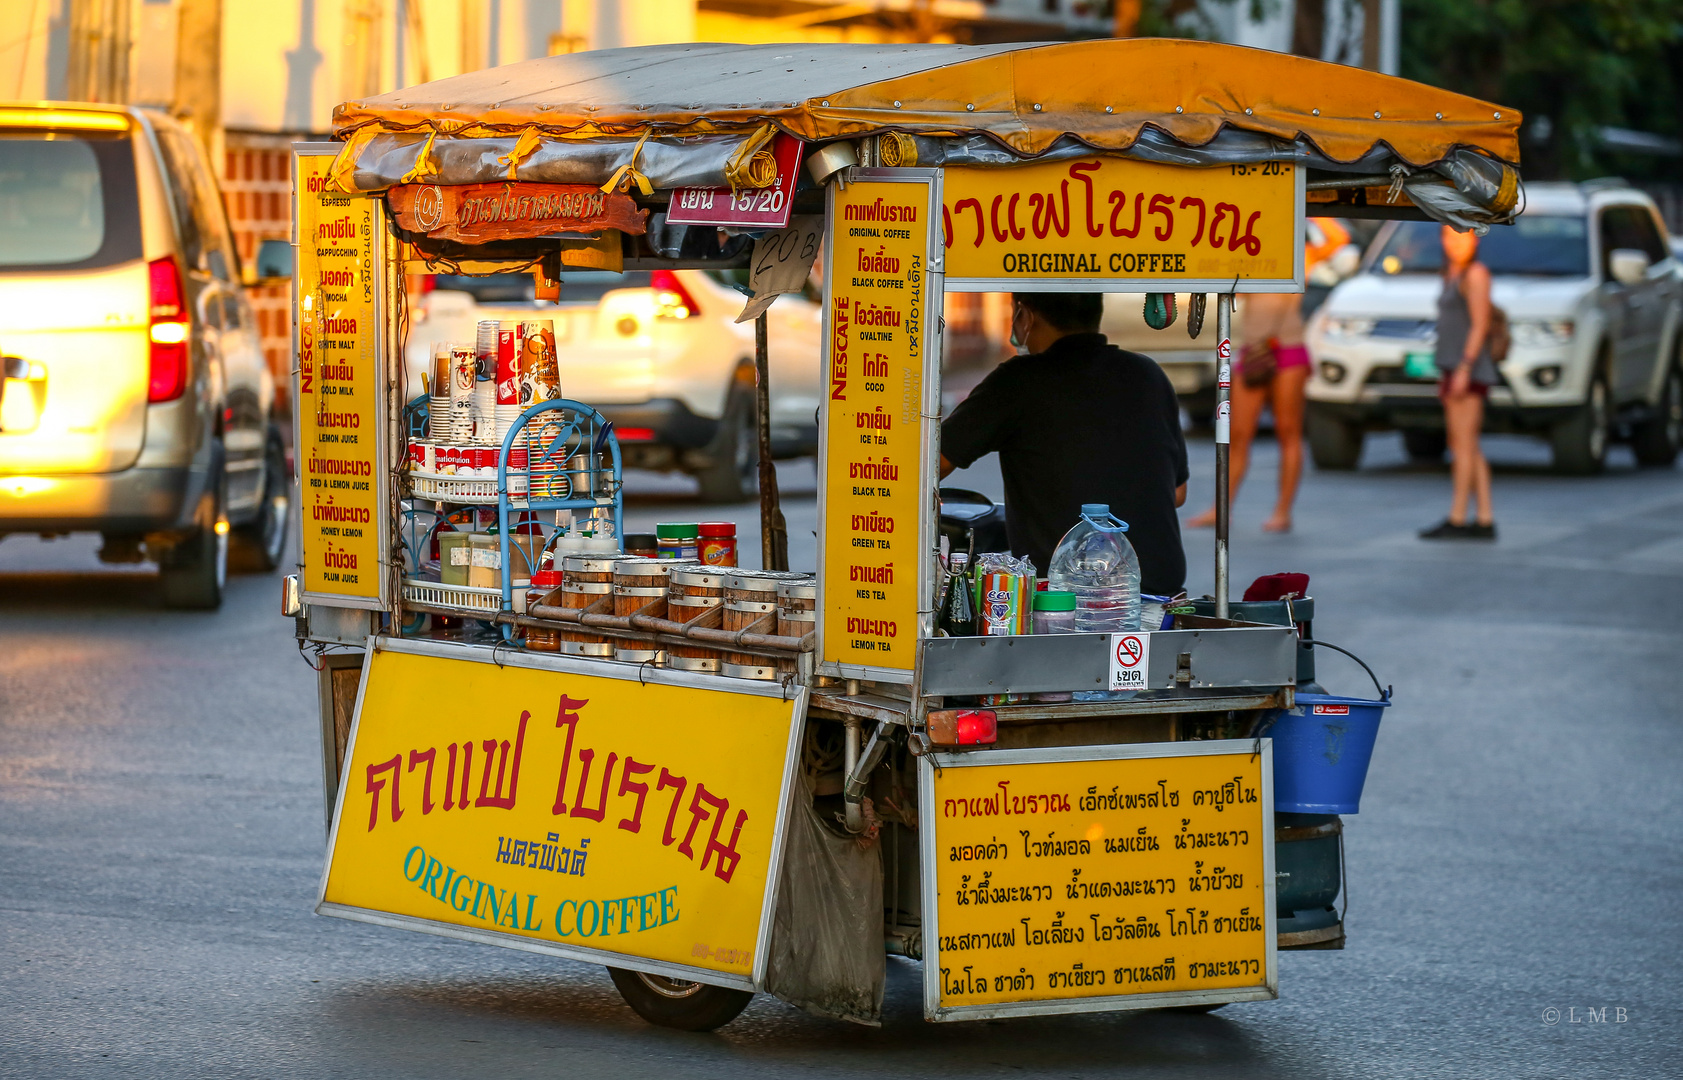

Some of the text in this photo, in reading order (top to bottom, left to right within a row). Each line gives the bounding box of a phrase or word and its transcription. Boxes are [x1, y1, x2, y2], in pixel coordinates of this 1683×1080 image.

[1262, 160, 1290, 176] 20.-
[322, 198, 351, 206] ESPRESSO
[730, 190, 784, 212] 15/20
[844, 198, 916, 222] กาแฟโบราณ
[320, 216, 356, 246] คาปูชิโน
[849, 228, 910, 239] ORIGINAL COFFEE
[755, 230, 798, 276] 20
[858, 245, 900, 274] โอเลี้ยง
[1002, 253, 1186, 272] ORIGINAL COFFEE
[852, 278, 904, 288] BLACK COFFEE
[326, 294, 348, 302] MOCHA
[905, 254, 920, 357] เหมือนเดิม
[854, 300, 900, 327] โอวัลติน
[302, 294, 312, 394] NESCAF
[338, 340, 354, 350] MALT
[860, 332, 892, 342] OVALTINE
[320, 358, 354, 381] นมเย็น
[863, 352, 888, 378] โกโก้
[338, 386, 354, 396] MILK
[865, 382, 884, 392] COCO
[856, 406, 892, 430] ชาเย็น
[318, 434, 358, 444] LEMON JUICE
[860, 434, 888, 445] ICE TEA
[308, 447, 371, 476] น้ำแดงมะนาว
[850, 457, 898, 482] ชาดำเย็น
[310, 478, 370, 490] RED & LEMON JUICE
[852, 486, 891, 498] BLACK TEA
[321, 526, 362, 537] HONEY LEMON
[852, 510, 894, 534] ชาเขียว
[852, 538, 890, 550] GREEN TEA
[324, 541, 357, 570] น้ำบ๊วย
[324, 572, 358, 584] PLUM JUICE
[850, 562, 894, 584] ชาเนสที
[856, 589, 886, 600] NES TEA
[847, 616, 897, 638] ชามะนาว
[851, 639, 892, 652] LEMON TEA
[1117, 670, 1141, 682] เขต
[365, 694, 748, 884] กาแฟ โบราณ
[944, 776, 1258, 818] กาแฟโบราณ เอ็กซ์เพรสโซ คาปูชิโน
[950, 818, 1248, 862] มอคค่า ไวท์มอล นมเย็น น้ำมะนาว
[496, 832, 592, 878] นครพิงค์
[403, 846, 680, 938] ORIGINAL COFFEE
[956, 860, 1243, 906] น้ำผึ้งมะนาว น้ำแดงมะนาว น้ำบ๊วย
[938, 906, 1262, 952] เนสกาแฟ โอเลี้ยง โอวัลติน โกโก้ ชาเย็น
[940, 957, 1259, 995] ไมโล ชาดำ ชาเขียว ชาเนสที ชามะนาว
